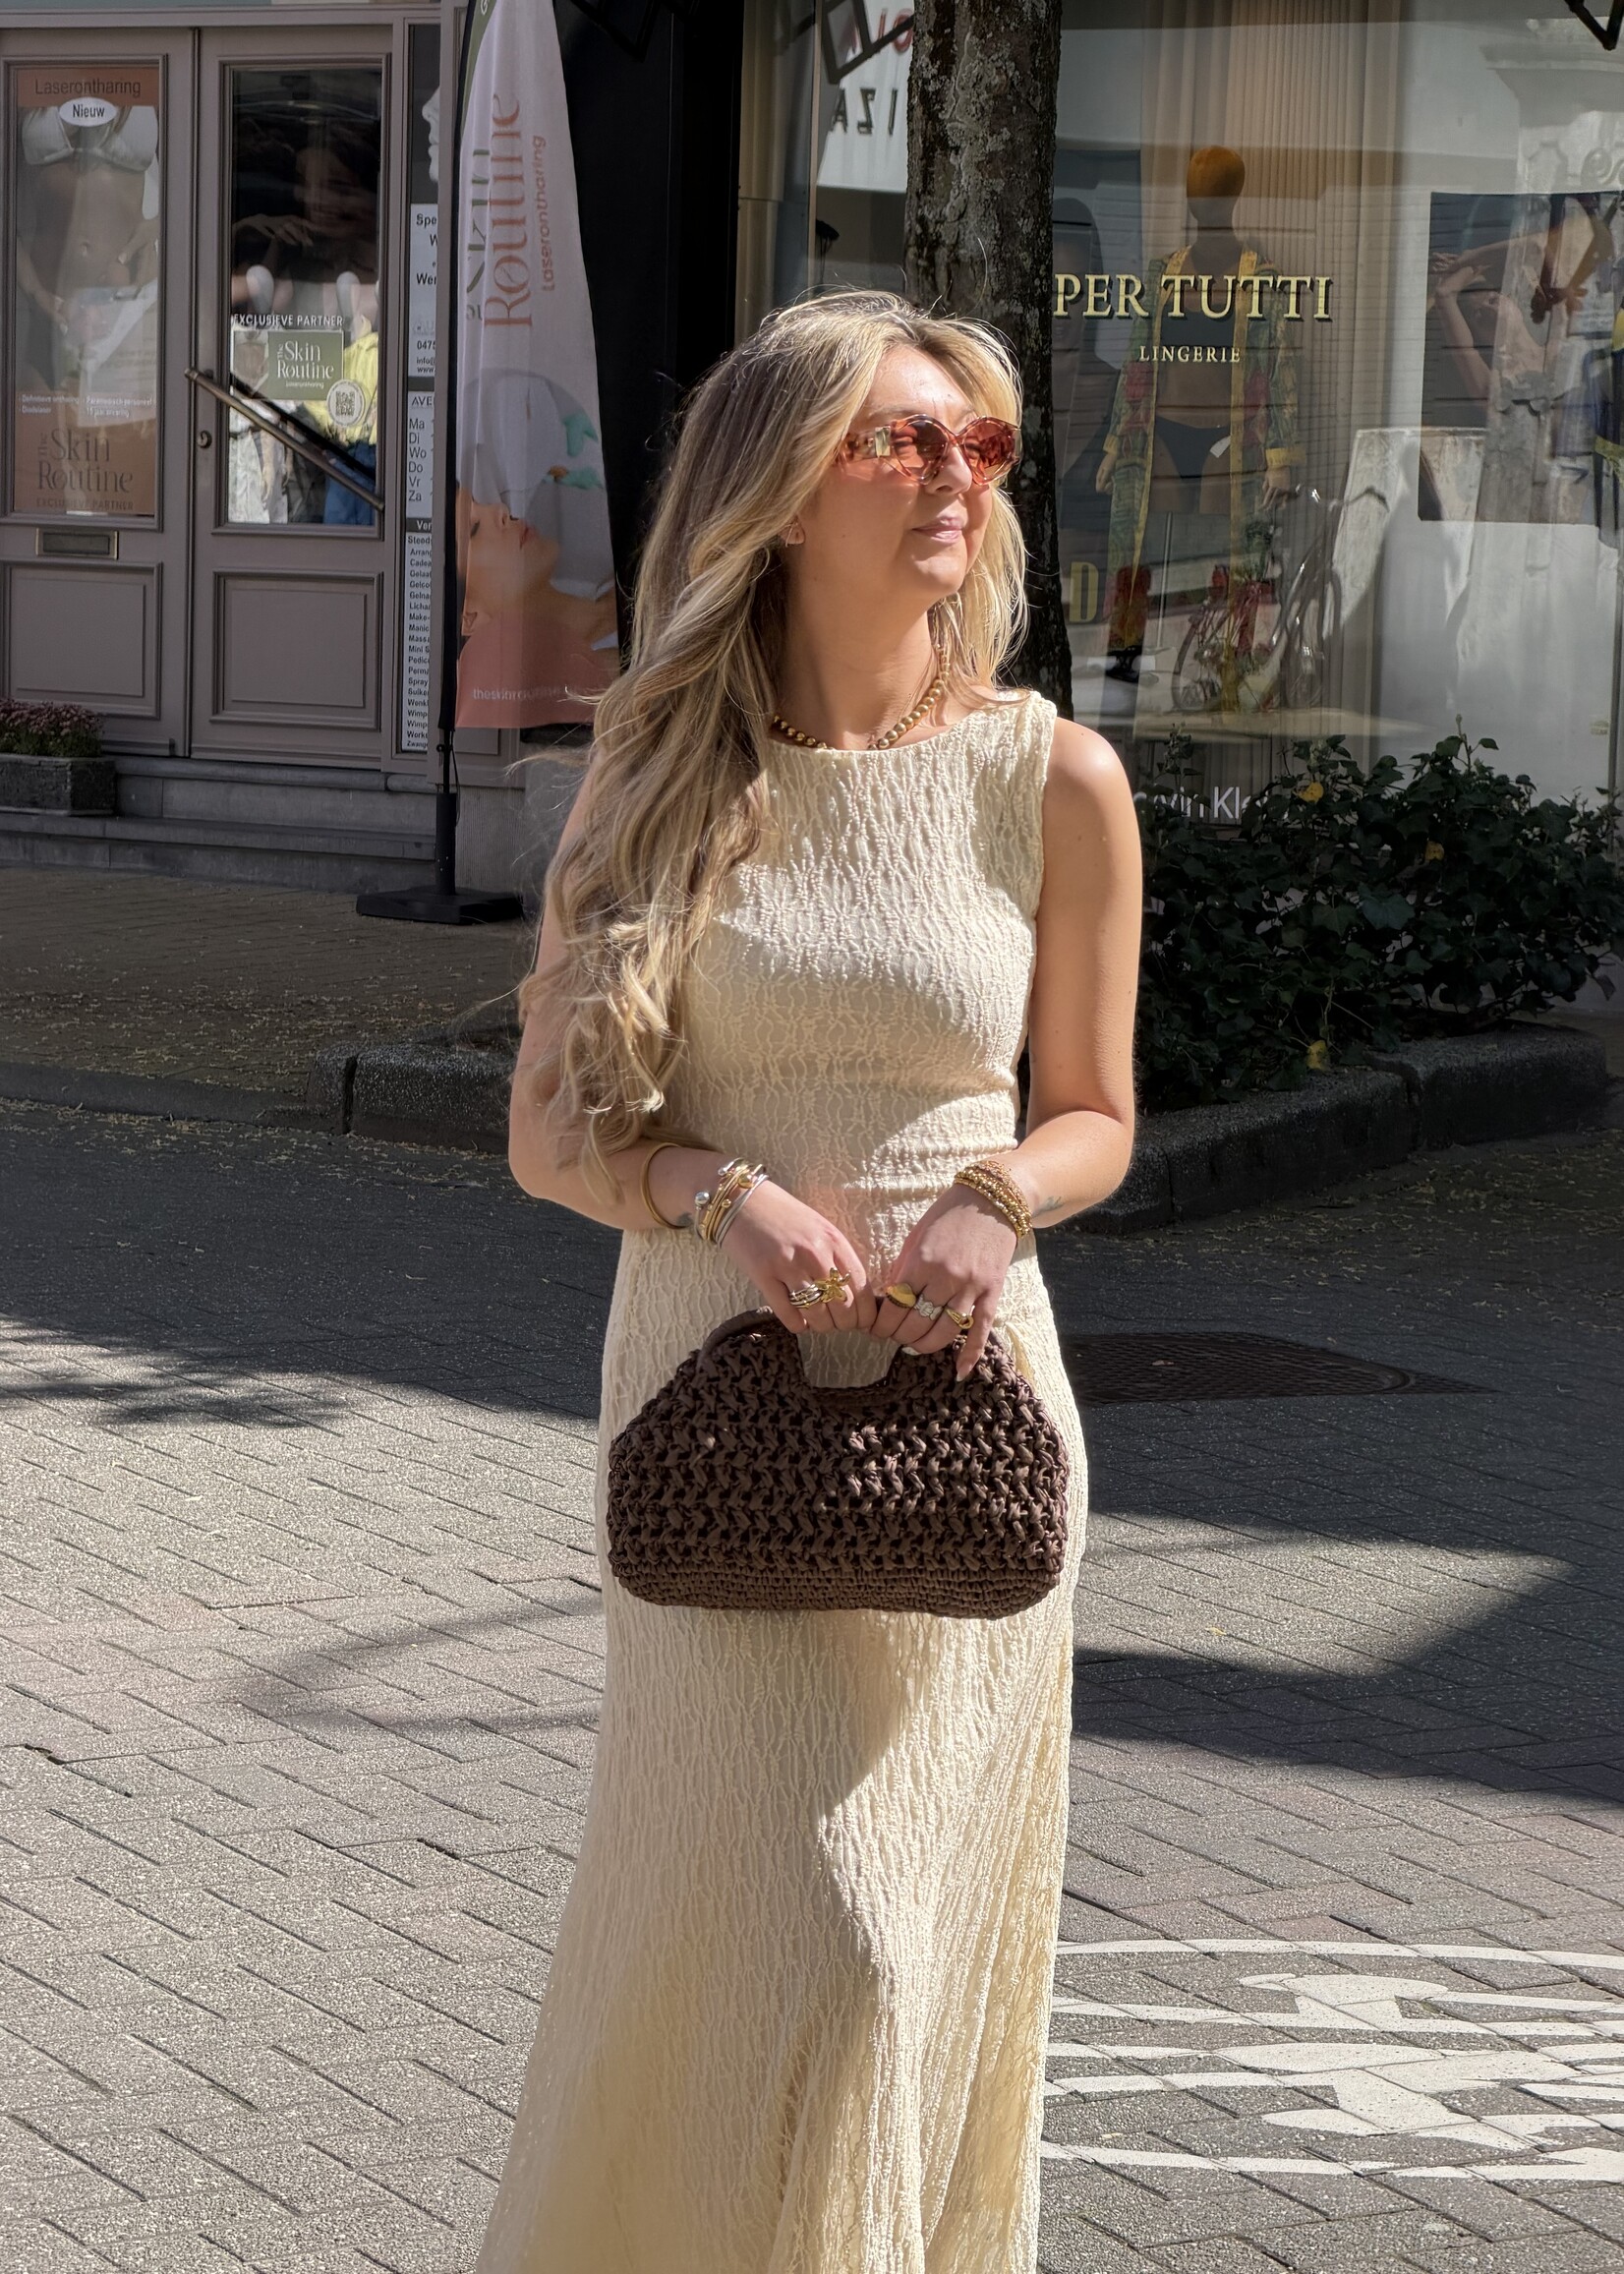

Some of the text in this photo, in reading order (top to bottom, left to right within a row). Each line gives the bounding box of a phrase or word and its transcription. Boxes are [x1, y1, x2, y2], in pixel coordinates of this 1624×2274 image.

[35, 79, 142, 97] Laserontharing
[73, 104, 105, 118] Nieuw
[484, 93, 533, 327] Routine
[1053, 273, 1331, 320] PER TUTTI
[233, 314, 343, 327] EXCLUSIEVE PARTNER
[285, 340, 320, 362] Skin
[1139, 345, 1241, 363] LINGERIE
[277, 360, 334, 380] Routine
[409, 418, 425, 430] Ma
[50, 428, 110, 462] Skin
[408, 432, 420, 444] Di
[409, 446, 427, 459] Wo
[408, 461, 424, 473] Do
[38, 460, 134, 494] Routine
[409, 476, 421, 488] Vr
[408, 490, 422, 502] Za
